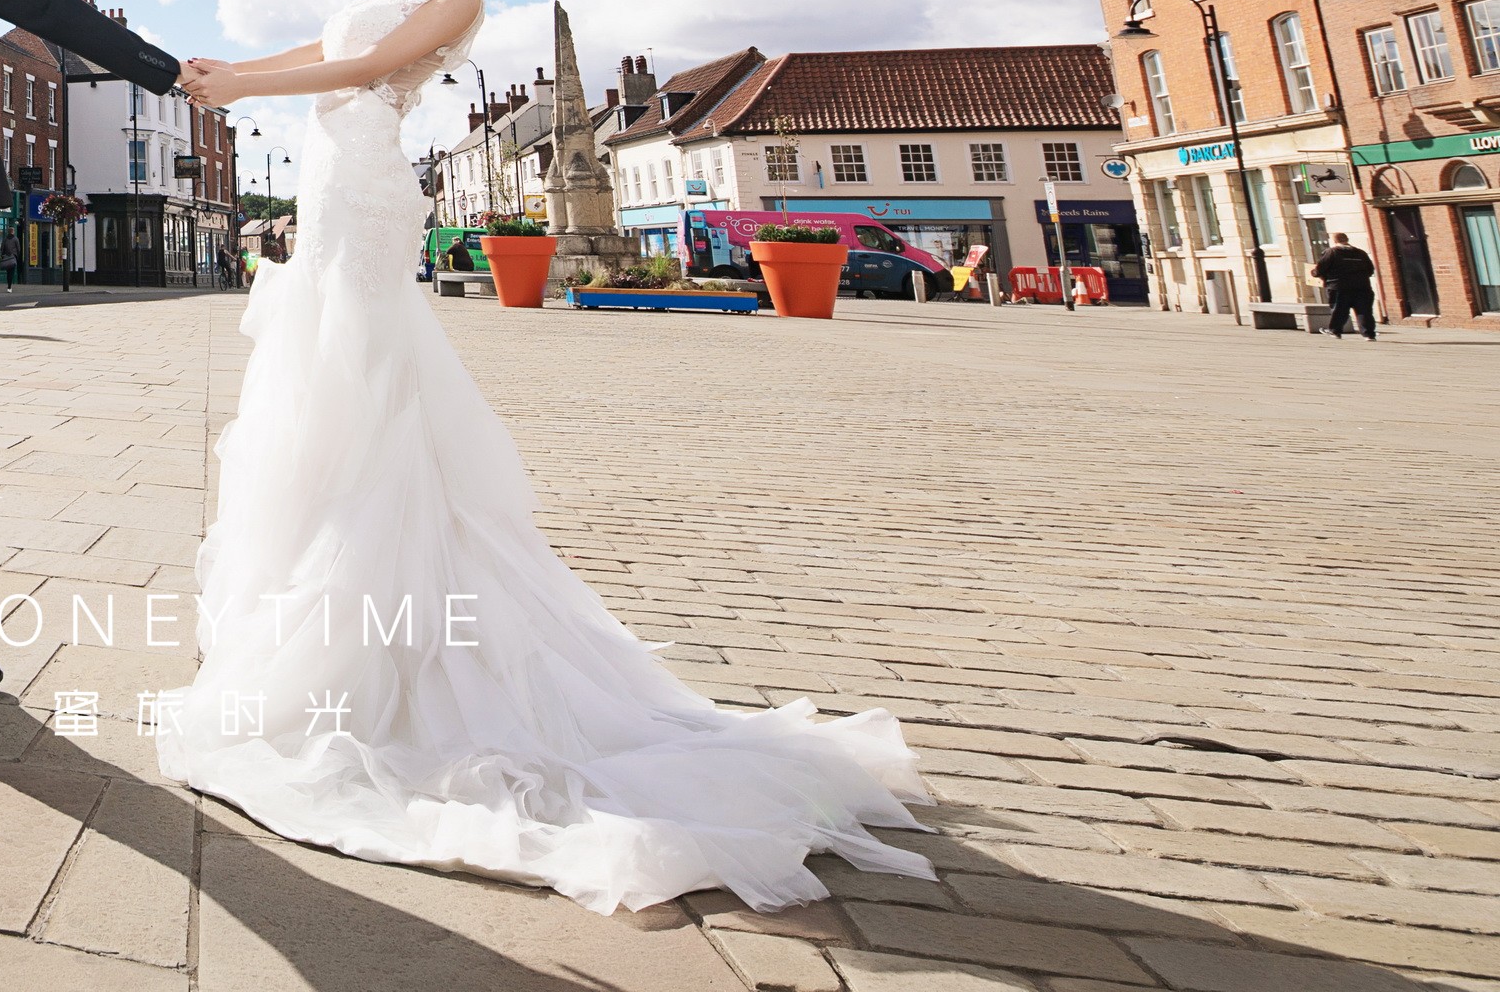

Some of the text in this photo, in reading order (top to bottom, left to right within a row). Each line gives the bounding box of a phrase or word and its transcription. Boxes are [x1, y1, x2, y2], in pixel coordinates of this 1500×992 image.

[1190, 142, 1237, 163] BARCLAY
[893, 208, 912, 216] TUI
[475, 254, 488, 262] Ltd
